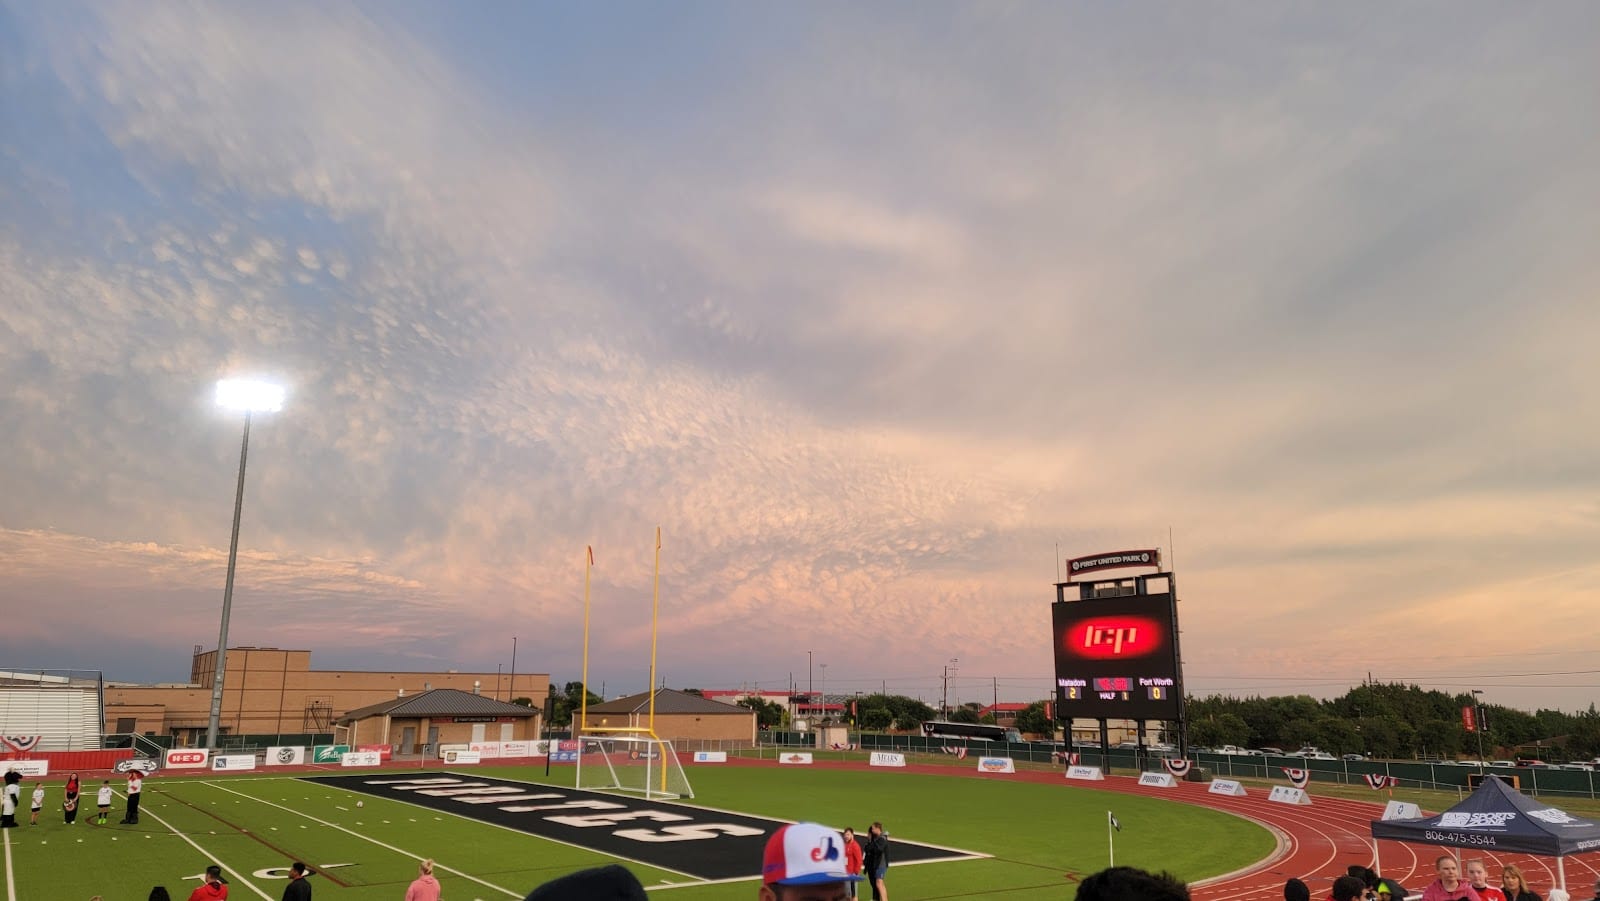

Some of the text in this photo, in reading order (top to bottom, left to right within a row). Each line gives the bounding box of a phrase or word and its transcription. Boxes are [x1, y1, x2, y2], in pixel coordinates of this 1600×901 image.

[1080, 555, 1141, 569] FIRST UNITED PARK
[1058, 678, 1087, 687] Matadors
[1139, 677, 1153, 687] Fort
[1152, 677, 1174, 687] Worth
[1069, 687, 1077, 699] 2
[1099, 691, 1116, 700] HALF
[1152, 687, 1161, 699] 0
[1471, 812, 1516, 820] SPORTS
[1425, 830, 1496, 846] 806-475-5544
